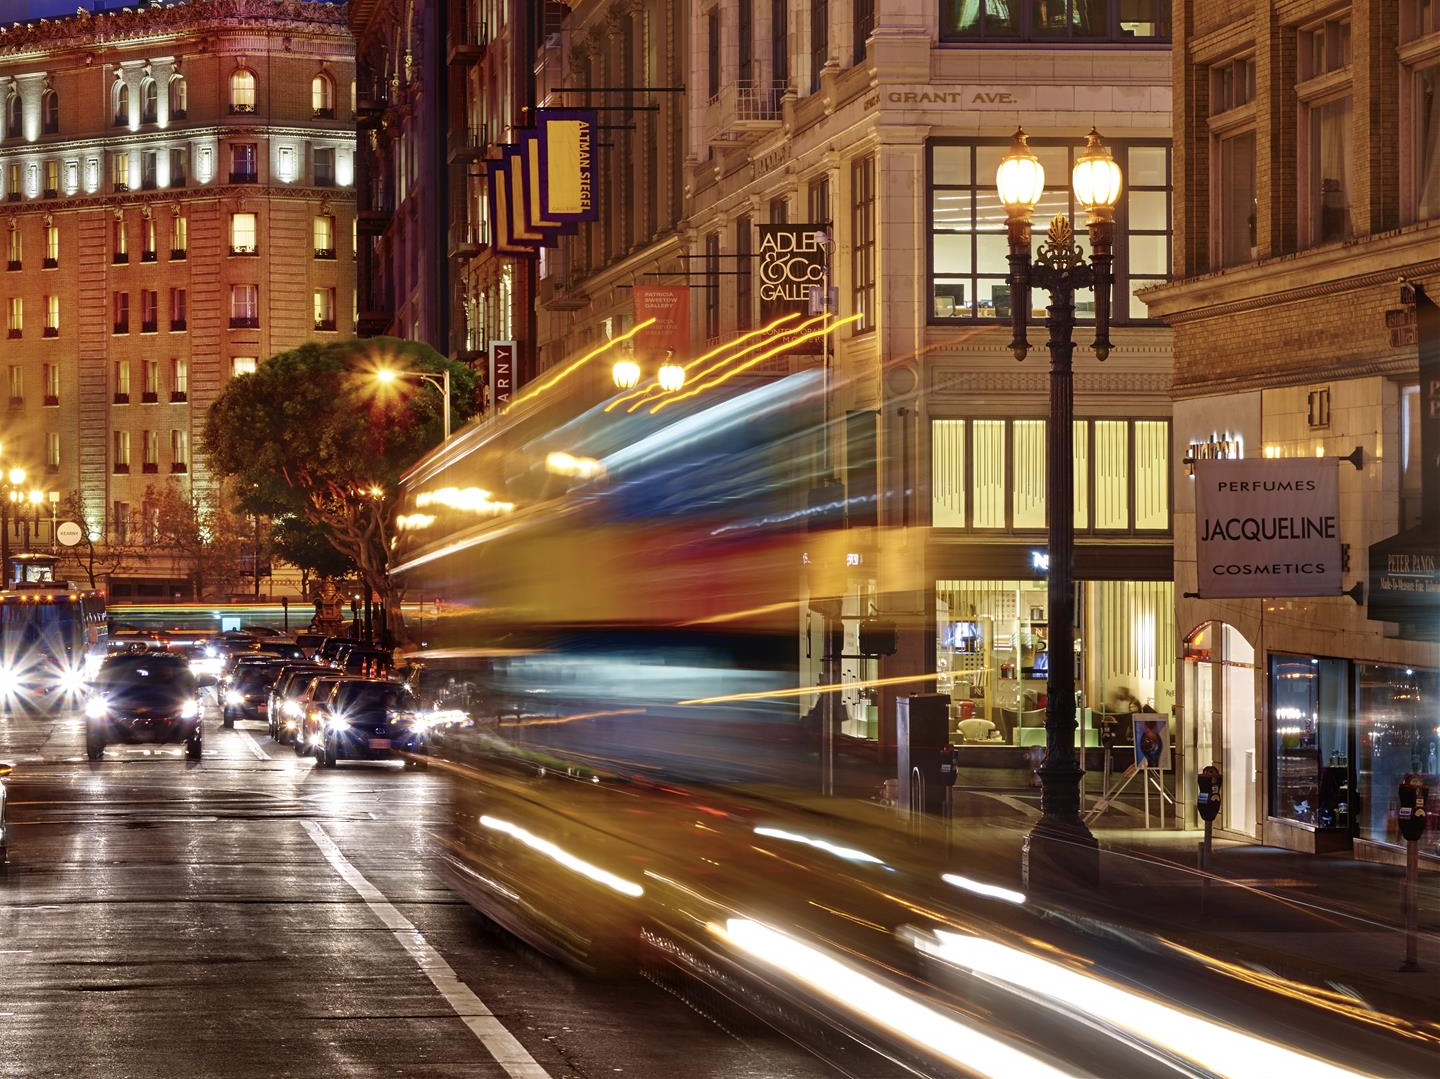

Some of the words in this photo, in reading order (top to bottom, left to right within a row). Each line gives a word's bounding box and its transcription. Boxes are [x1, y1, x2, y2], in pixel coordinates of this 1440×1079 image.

[887, 92, 960, 104] GRANT
[971, 93, 1017, 104] AVE.
[579, 120, 591, 168] ALTMAN
[760, 284, 821, 301] GALLE
[1218, 480, 1316, 492] PERFUMES
[1201, 516, 1336, 542] JACQUELINE
[1212, 563, 1326, 576] COSMETICS
[1387, 554, 1410, 573] PETER
